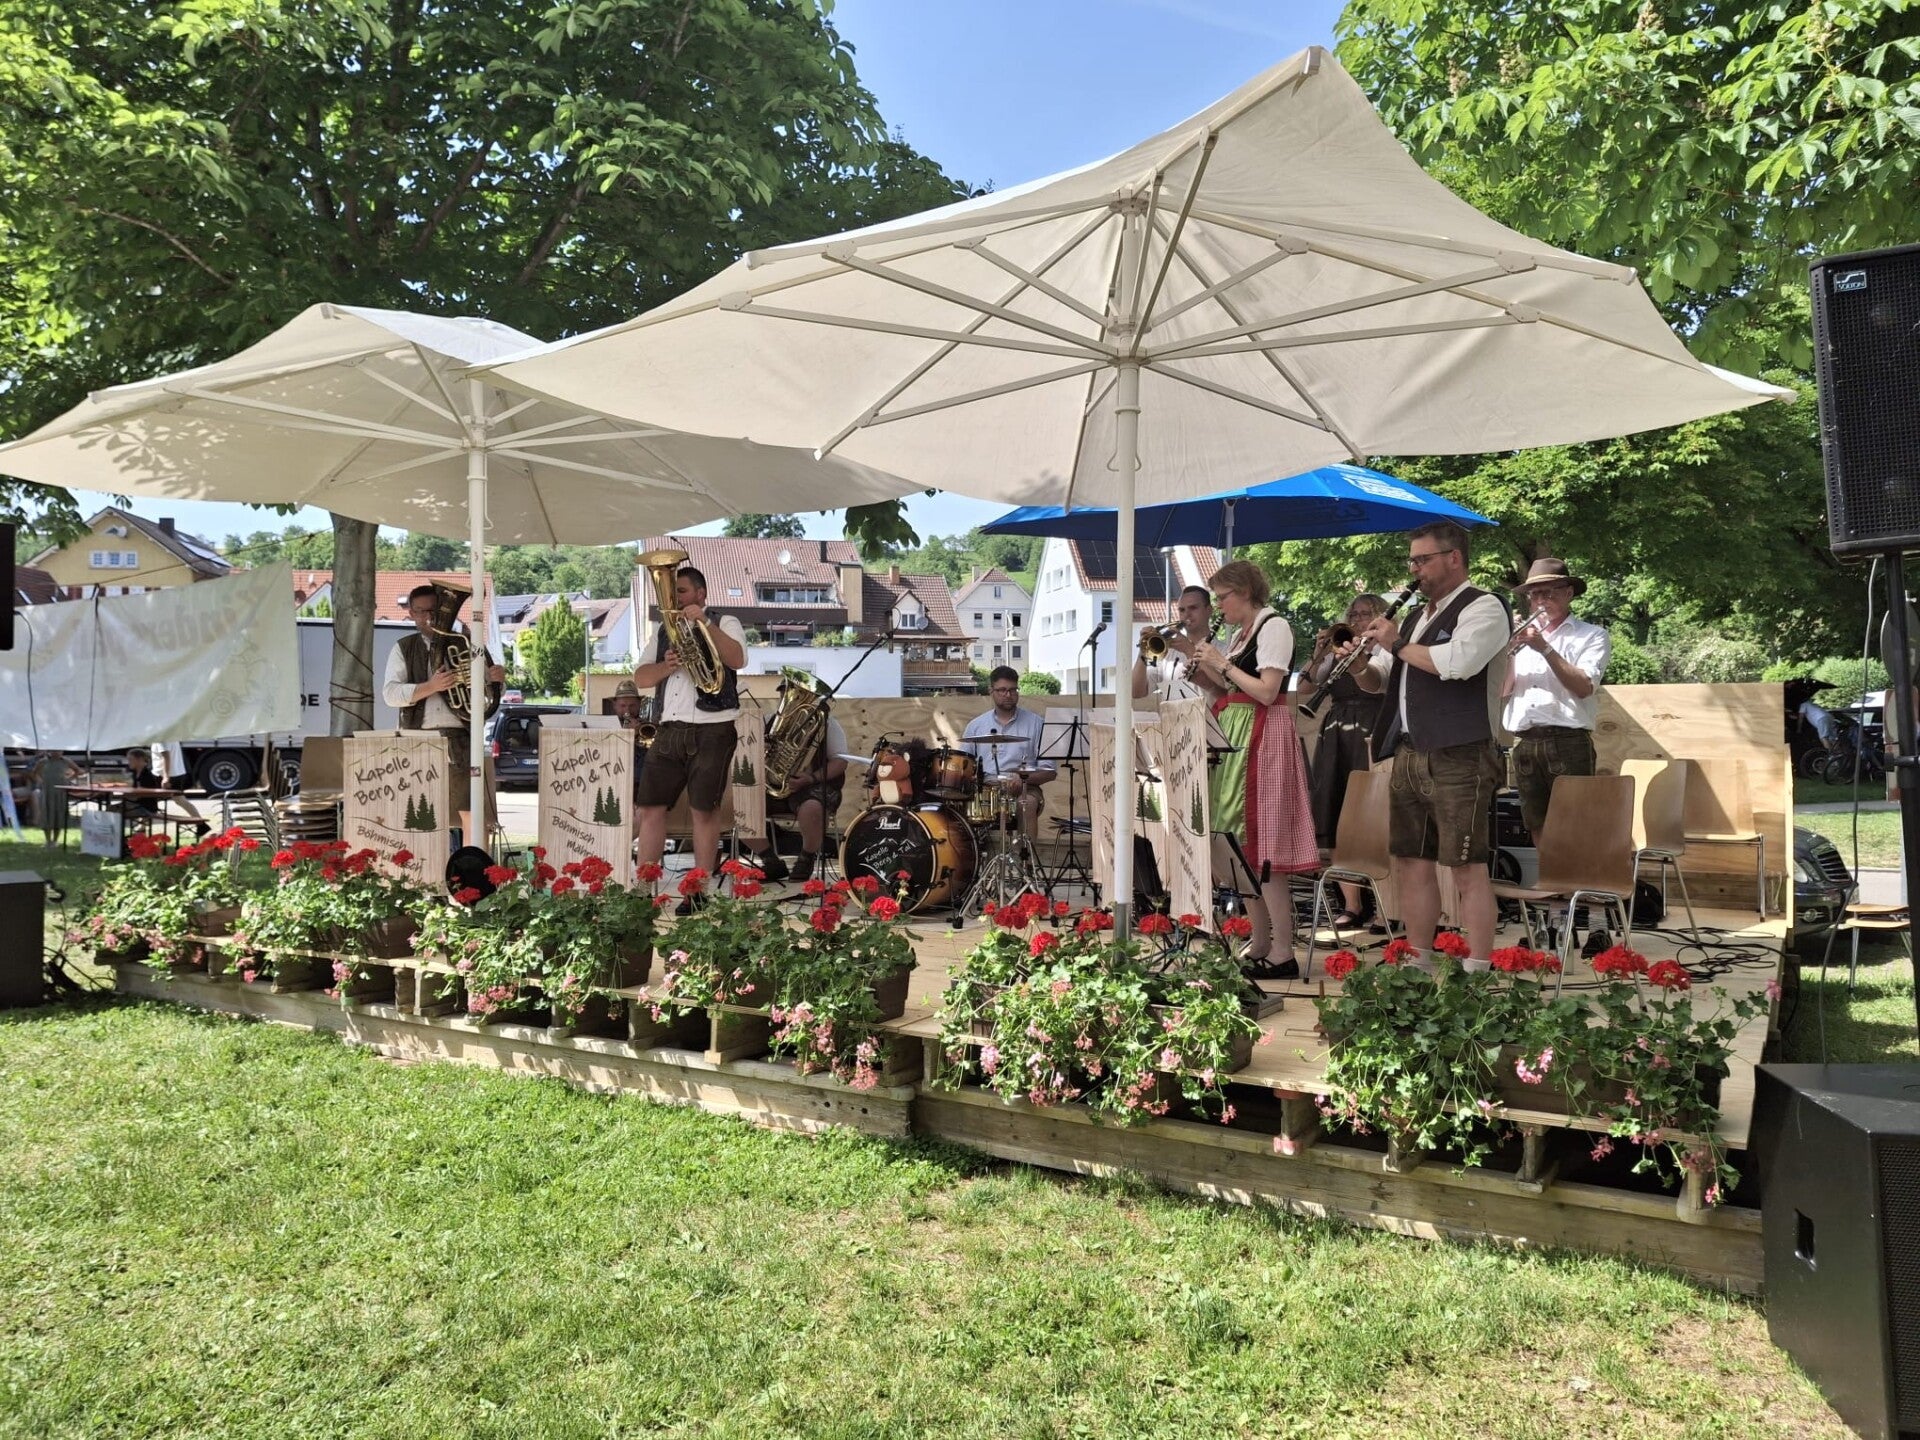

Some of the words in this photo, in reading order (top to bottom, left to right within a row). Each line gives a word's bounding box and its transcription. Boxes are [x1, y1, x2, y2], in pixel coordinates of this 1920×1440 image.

[354, 756, 411, 784] Kapelle
[551, 747, 601, 775] Kapelle
[353, 783, 396, 806] Berg
[397, 776, 411, 792] &
[411, 764, 440, 784] Tal
[550, 777, 587, 796] Berg
[588, 768, 600, 784] &
[600, 757, 626, 778] Tal
[551, 815, 596, 845] Böhmisch
[875, 816, 902, 830] Pearl
[356, 825, 408, 850] Böhmisch
[864, 846, 889, 864] Kapelle
[872, 856, 893, 870] Berg
[898, 843, 913, 854] Tal
